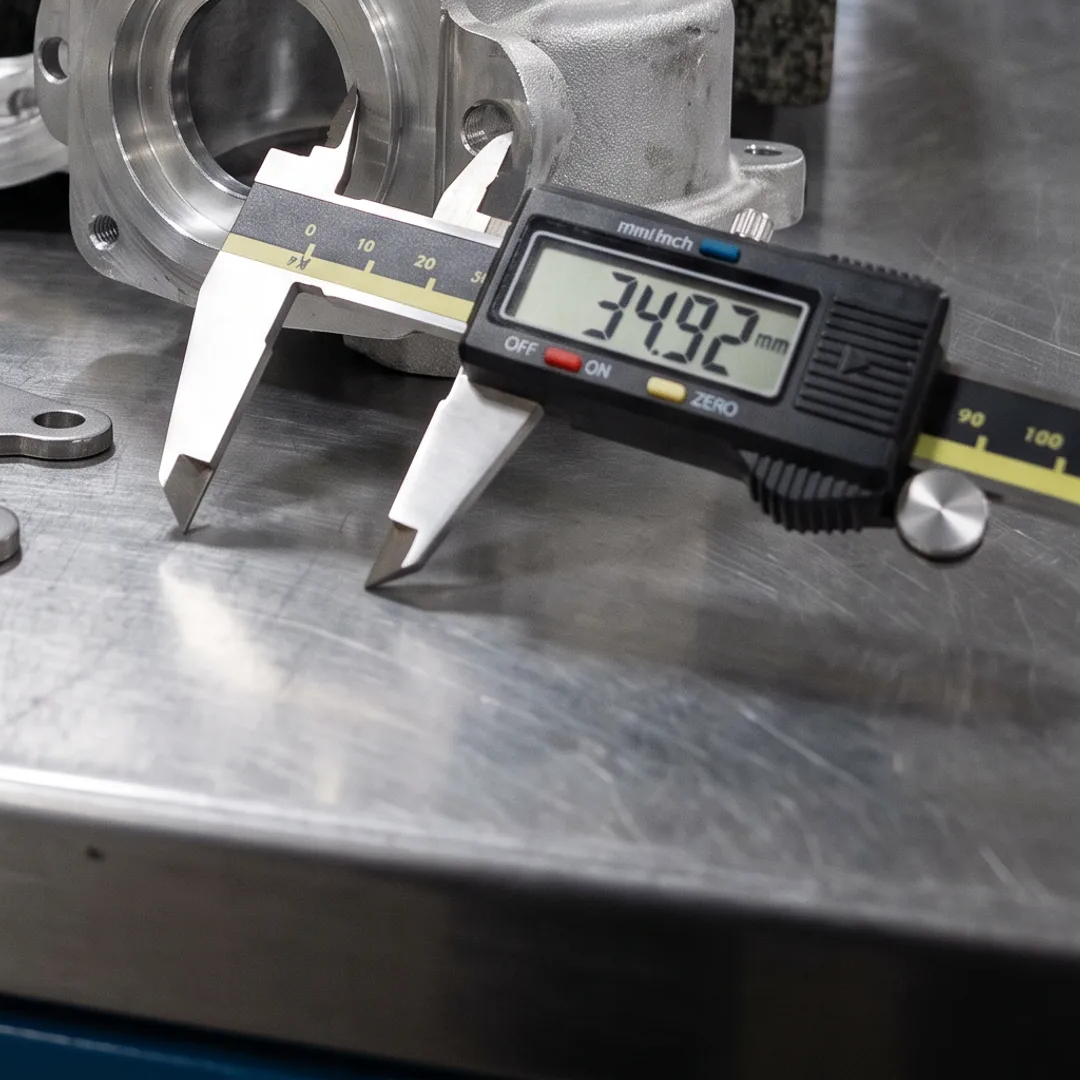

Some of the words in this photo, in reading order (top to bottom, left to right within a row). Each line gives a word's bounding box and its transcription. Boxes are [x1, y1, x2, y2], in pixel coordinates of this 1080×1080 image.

[304, 223, 317, 237] 0
[357, 237, 376, 253] 10
[414, 254, 437, 271] 20
[582, 270, 760, 377] 34.92
[754, 332, 791, 356] mm
[503, 335, 539, 357] OFF
[584, 359, 613, 379] ON
[689, 390, 739, 418] ZERO
[958, 407, 986, 428] 90
[1024, 426, 1064, 450] 100
